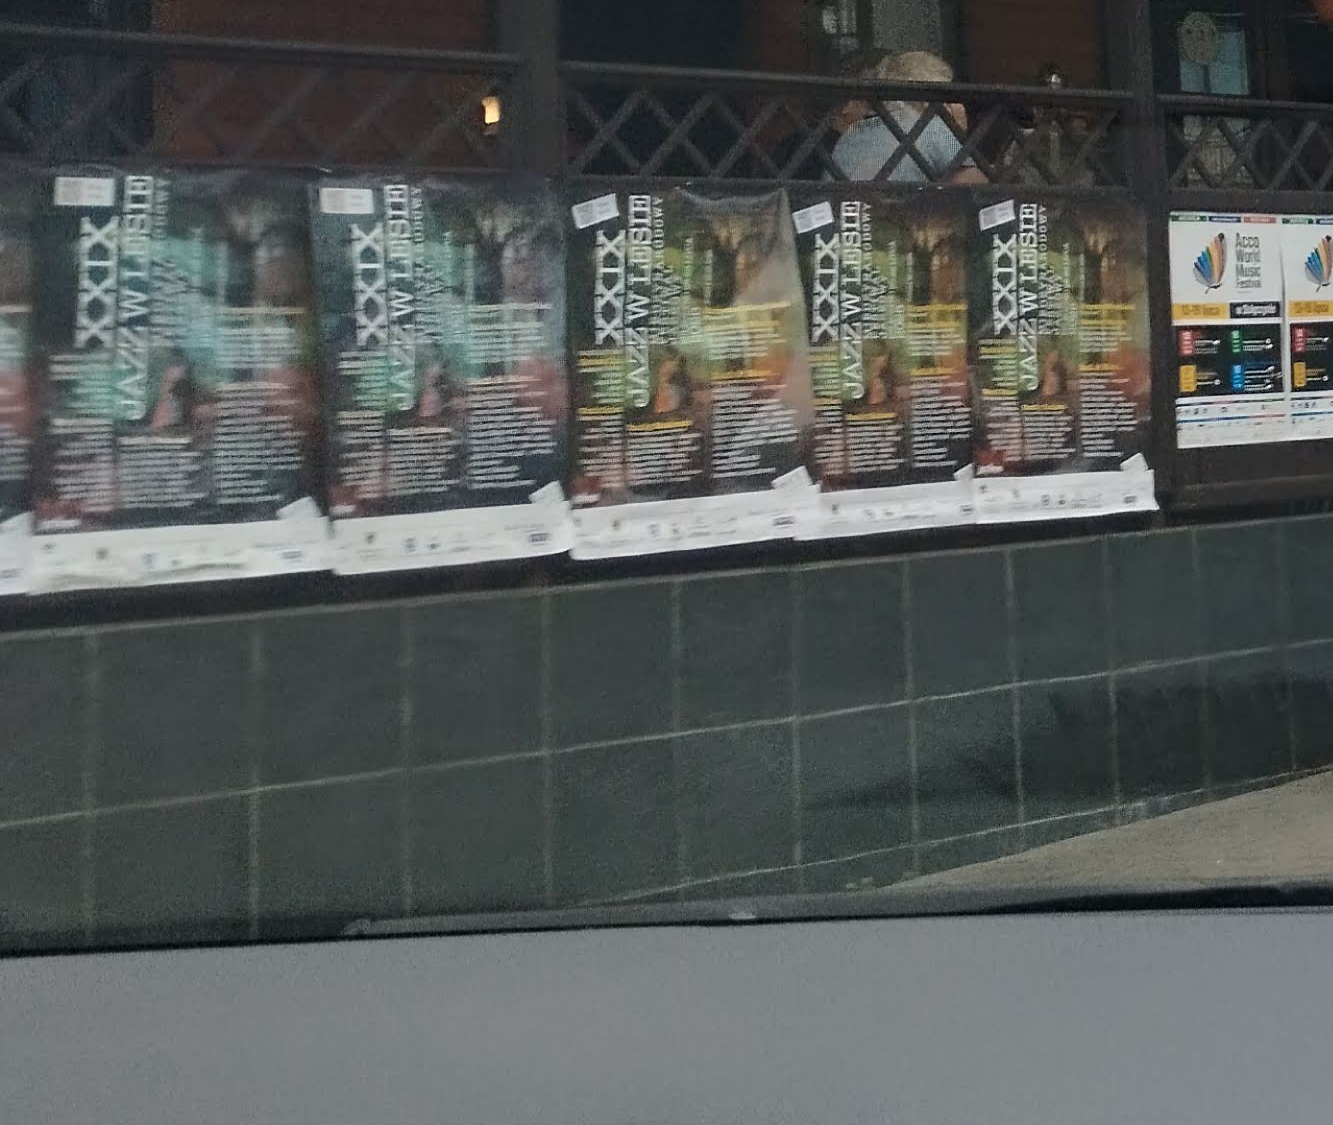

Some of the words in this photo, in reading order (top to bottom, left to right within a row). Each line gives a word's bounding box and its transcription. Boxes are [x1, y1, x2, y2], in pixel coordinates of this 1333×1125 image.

[1018, 203, 1038, 285] LESIE
[1235, 232, 1260, 249] Acco
[351, 222, 389, 347] XXIX
[594, 229, 626, 347] XXIX
[813, 232, 840, 343] XXIX
[993, 234, 1017, 336] XXIX
[1018, 287, 1038, 315] W
[625, 326, 650, 408] JAZZ
[840, 322, 864, 400] JAZZ
[1018, 317, 1039, 391] JAZZ
